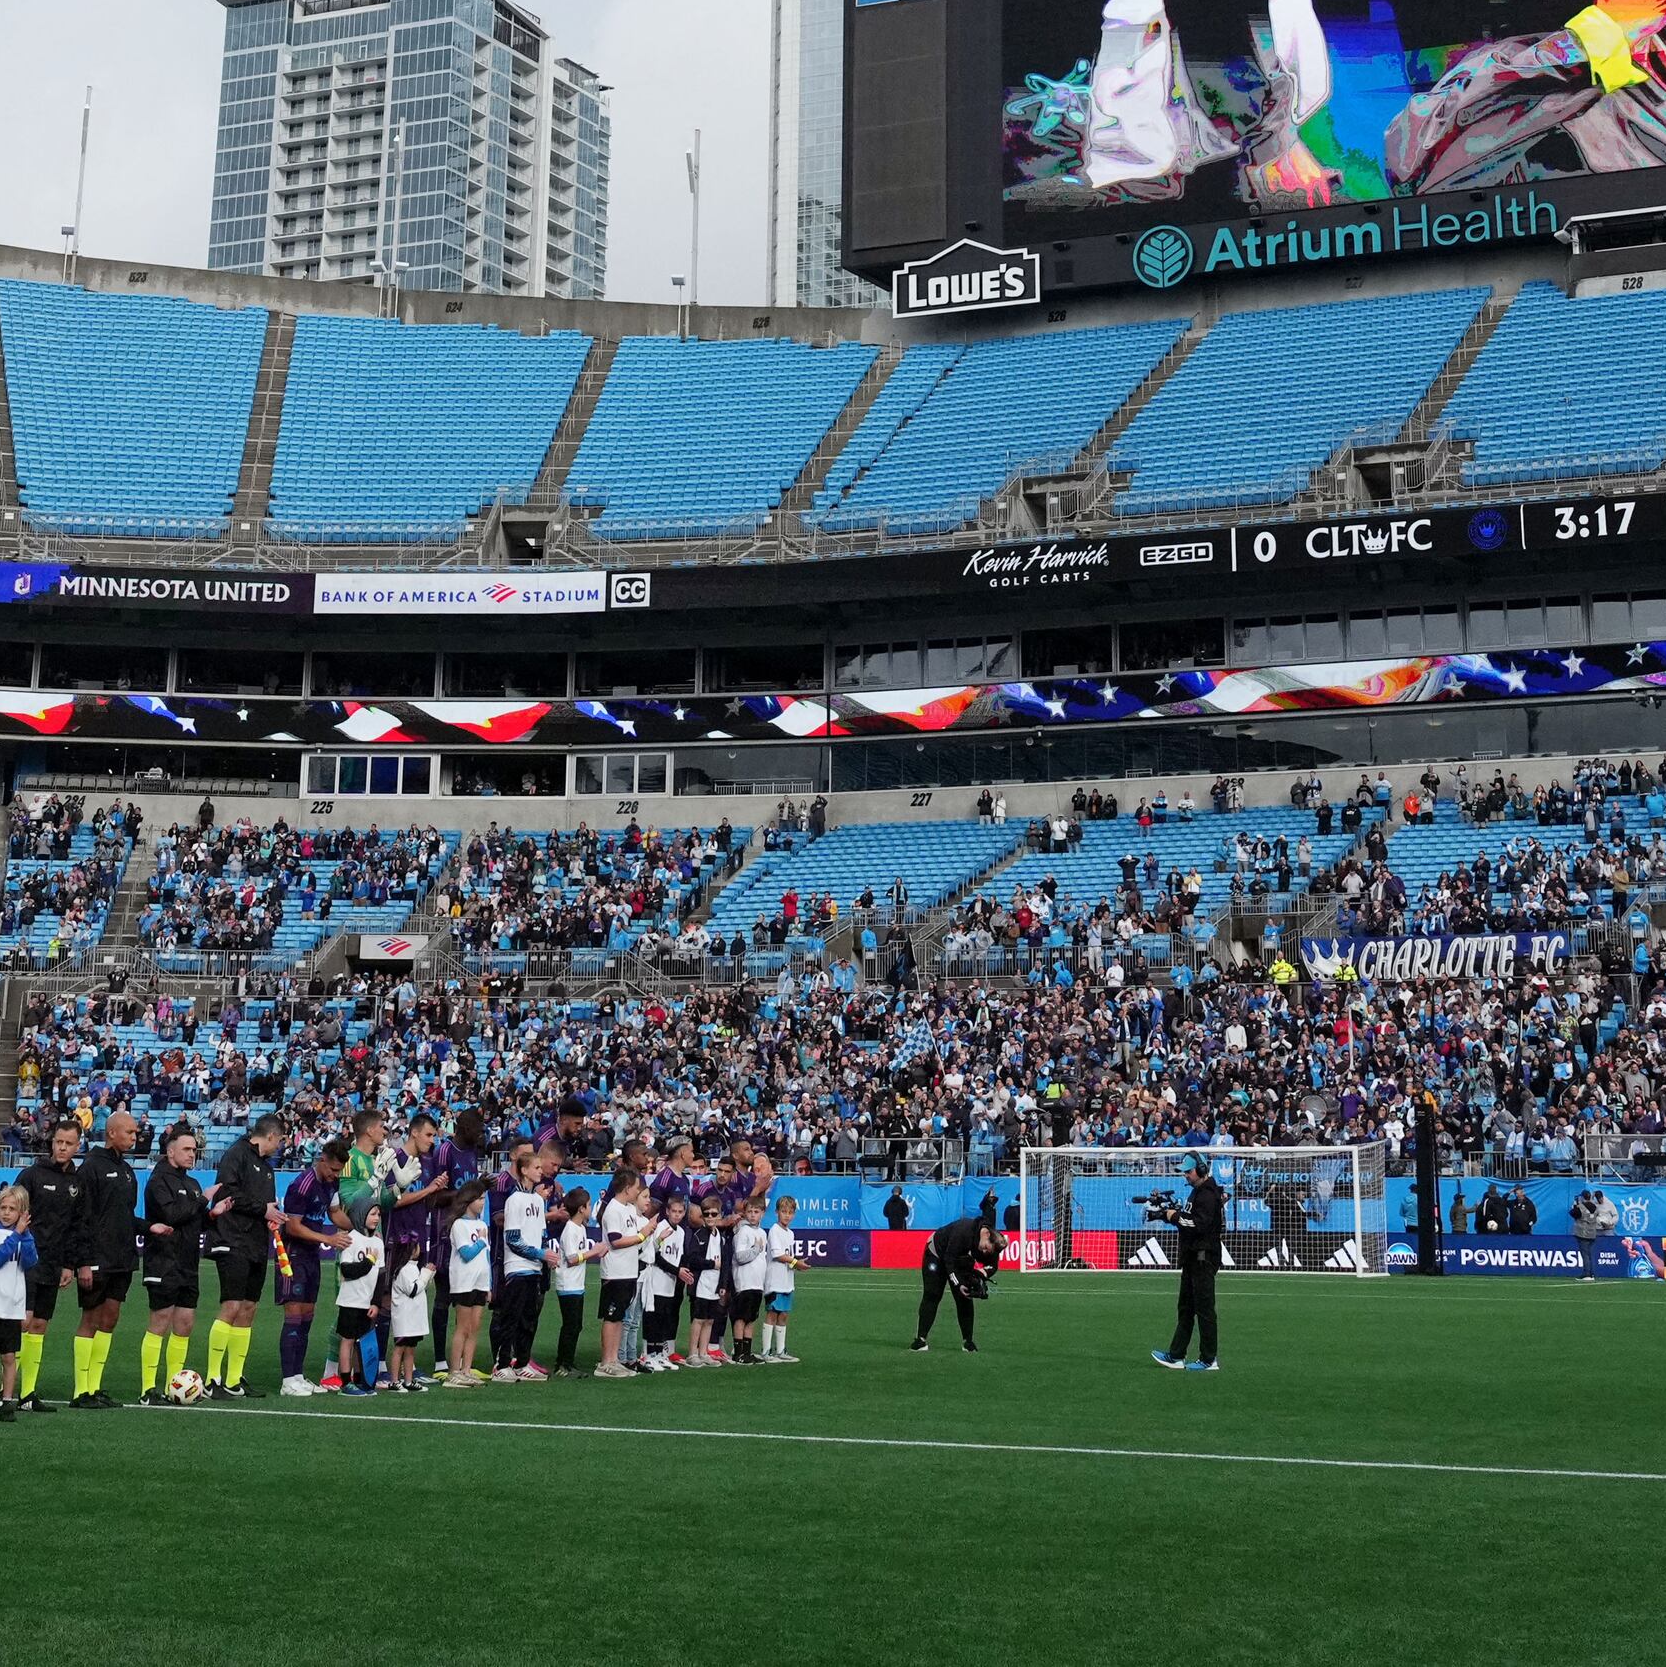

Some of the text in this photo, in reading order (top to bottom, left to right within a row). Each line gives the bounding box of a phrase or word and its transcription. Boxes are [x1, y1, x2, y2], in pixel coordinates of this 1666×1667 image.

[1203, 190, 1559, 272] Atrium Health
[908, 263, 1026, 308] LOWE'S
[1622, 276, 1644, 290] 528
[1554, 501, 1637, 540] 3:17
[1389, 518, 1433, 552] FC
[1143, 543, 1210, 564] EZGO
[1253, 531, 1277, 563] 0
[963, 548, 1023, 576] Kevin
[989, 570, 1091, 588] GOLF CARTS
[59, 574, 291, 603] MINNESOTA UNITED
[321, 588, 600, 603] BANK OF AMERICA STADIUM
[614, 579, 647, 601] CC
[310, 801, 335, 814] 225
[616, 800, 639, 815] 226
[910, 792, 933, 807] 227
[1359, 934, 1566, 980] CHARLOTTE FC
[1268, 1172, 1290, 1183] THE
[794, 1199, 849, 1213] AIMLER
[1239, 1199, 1269, 1212] TRU
[807, 1216, 835, 1227] North
[807, 1240, 828, 1257] FC
[1385, 1253, 1417, 1265] DAWN
